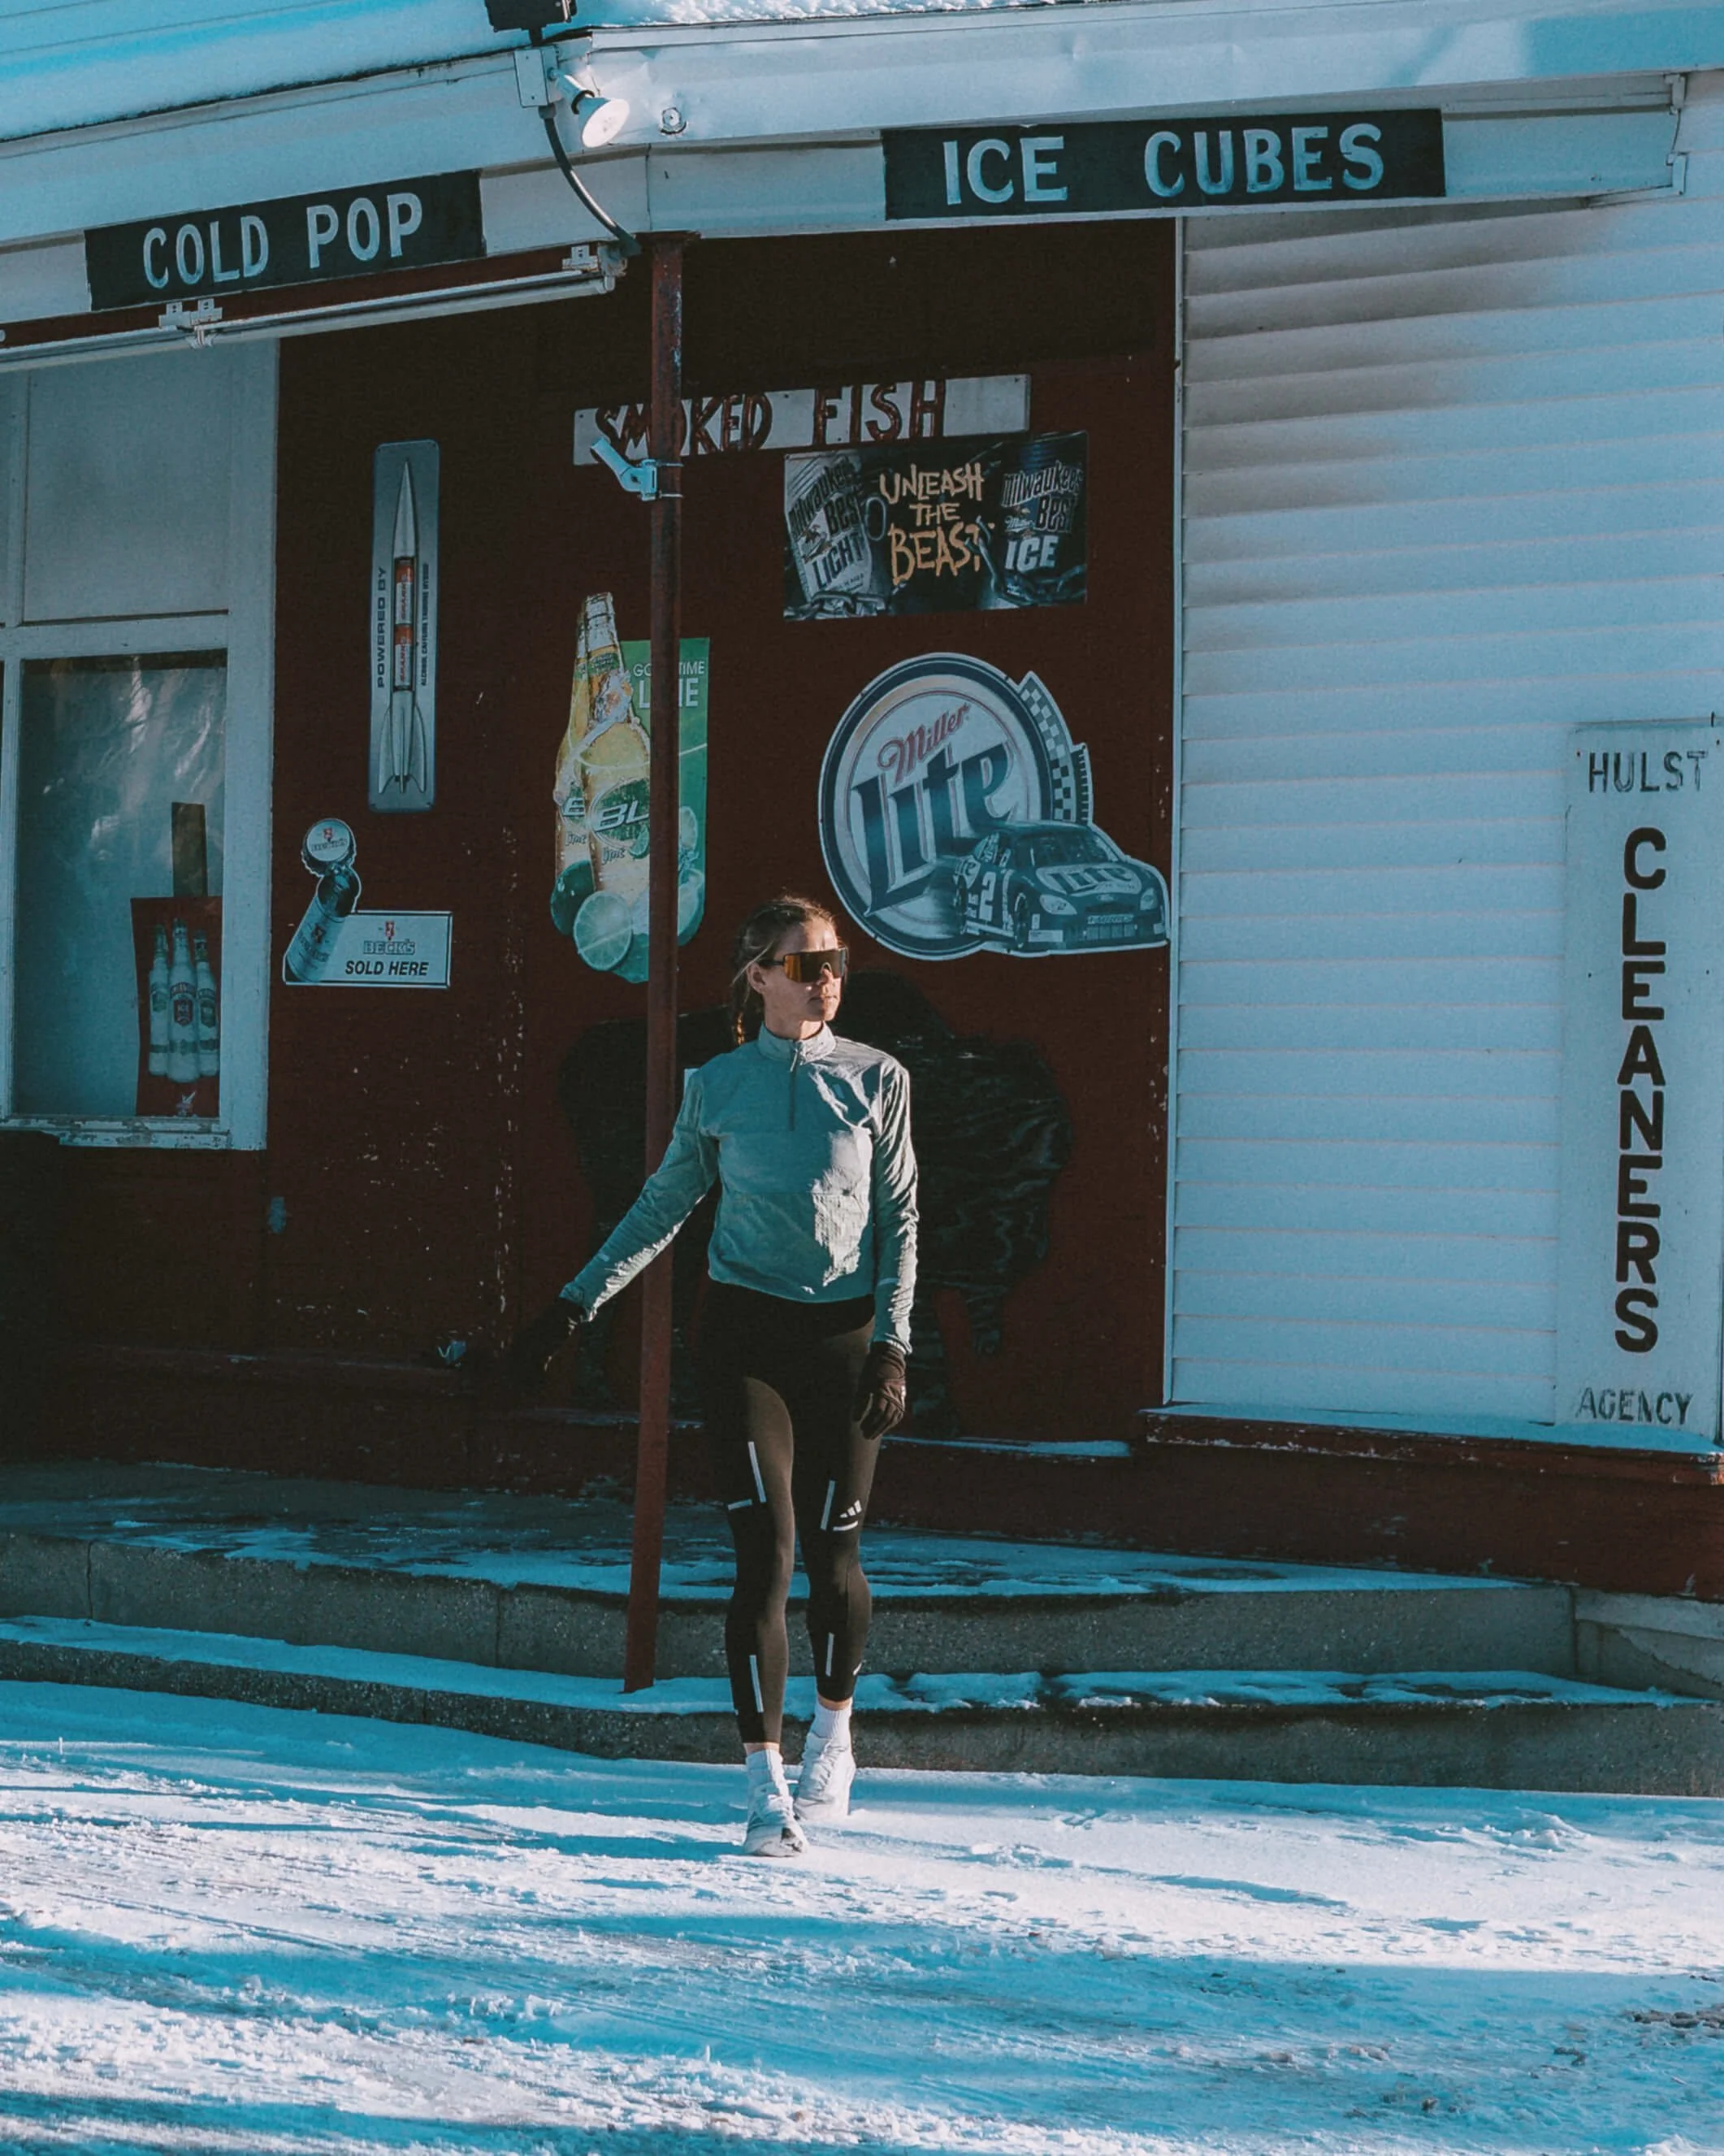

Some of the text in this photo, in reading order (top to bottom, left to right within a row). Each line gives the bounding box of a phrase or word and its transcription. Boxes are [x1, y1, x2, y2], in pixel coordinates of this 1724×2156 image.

[943, 122, 1384, 206] ICE CUBES
[142, 191, 423, 289] COLD POP
[591, 379, 945, 463] SMKED FISH
[879, 462, 985, 505] UNLEASH
[908, 501, 961, 527] THE
[812, 532, 864, 589] LIGHT
[887, 521, 996, 587] BEAST
[1005, 535, 1059, 574] ICE
[377, 566, 386, 688] POWERED BY
[877, 702, 971, 786] Miller
[1588, 749, 1709, 794] HULST
[850, 740, 1017, 918] Lite
[978, 871, 997, 922] 2
[344, 960, 429, 976] SOLD HERE
[363, 939, 416, 956] BECK'S
[1614, 826, 1667, 1355] CLEANERS
[1575, 1386, 1694, 1425] AGENCY
